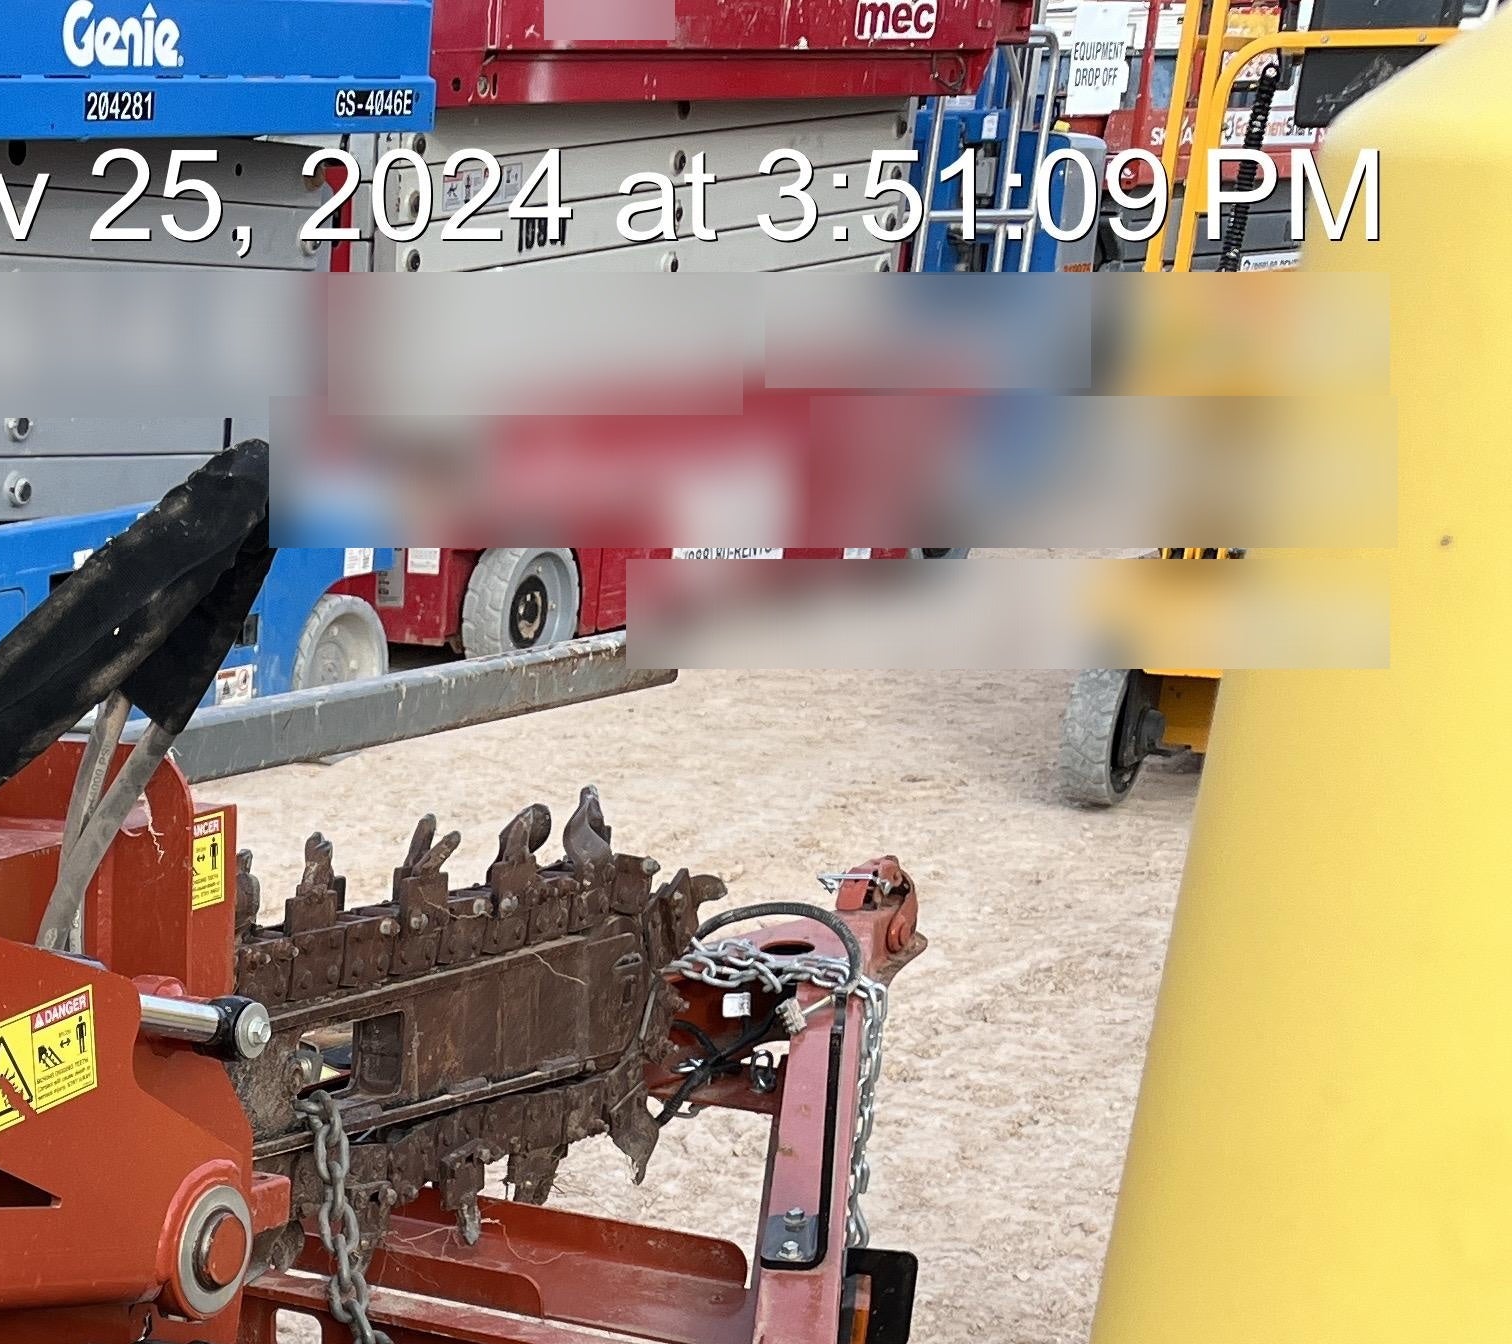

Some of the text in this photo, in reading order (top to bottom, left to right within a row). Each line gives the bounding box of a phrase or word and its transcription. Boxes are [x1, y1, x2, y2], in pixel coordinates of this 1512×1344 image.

[62, 0, 184, 68] Genie
[1073, 41, 1124, 61] EQUIPMENT
[1074, 67, 1119, 87] DROP OFF
[86, 91, 153, 120] 204281
[335, 89, 414, 117] GS-4046E
[44, 994, 87, 1024] DANGER
